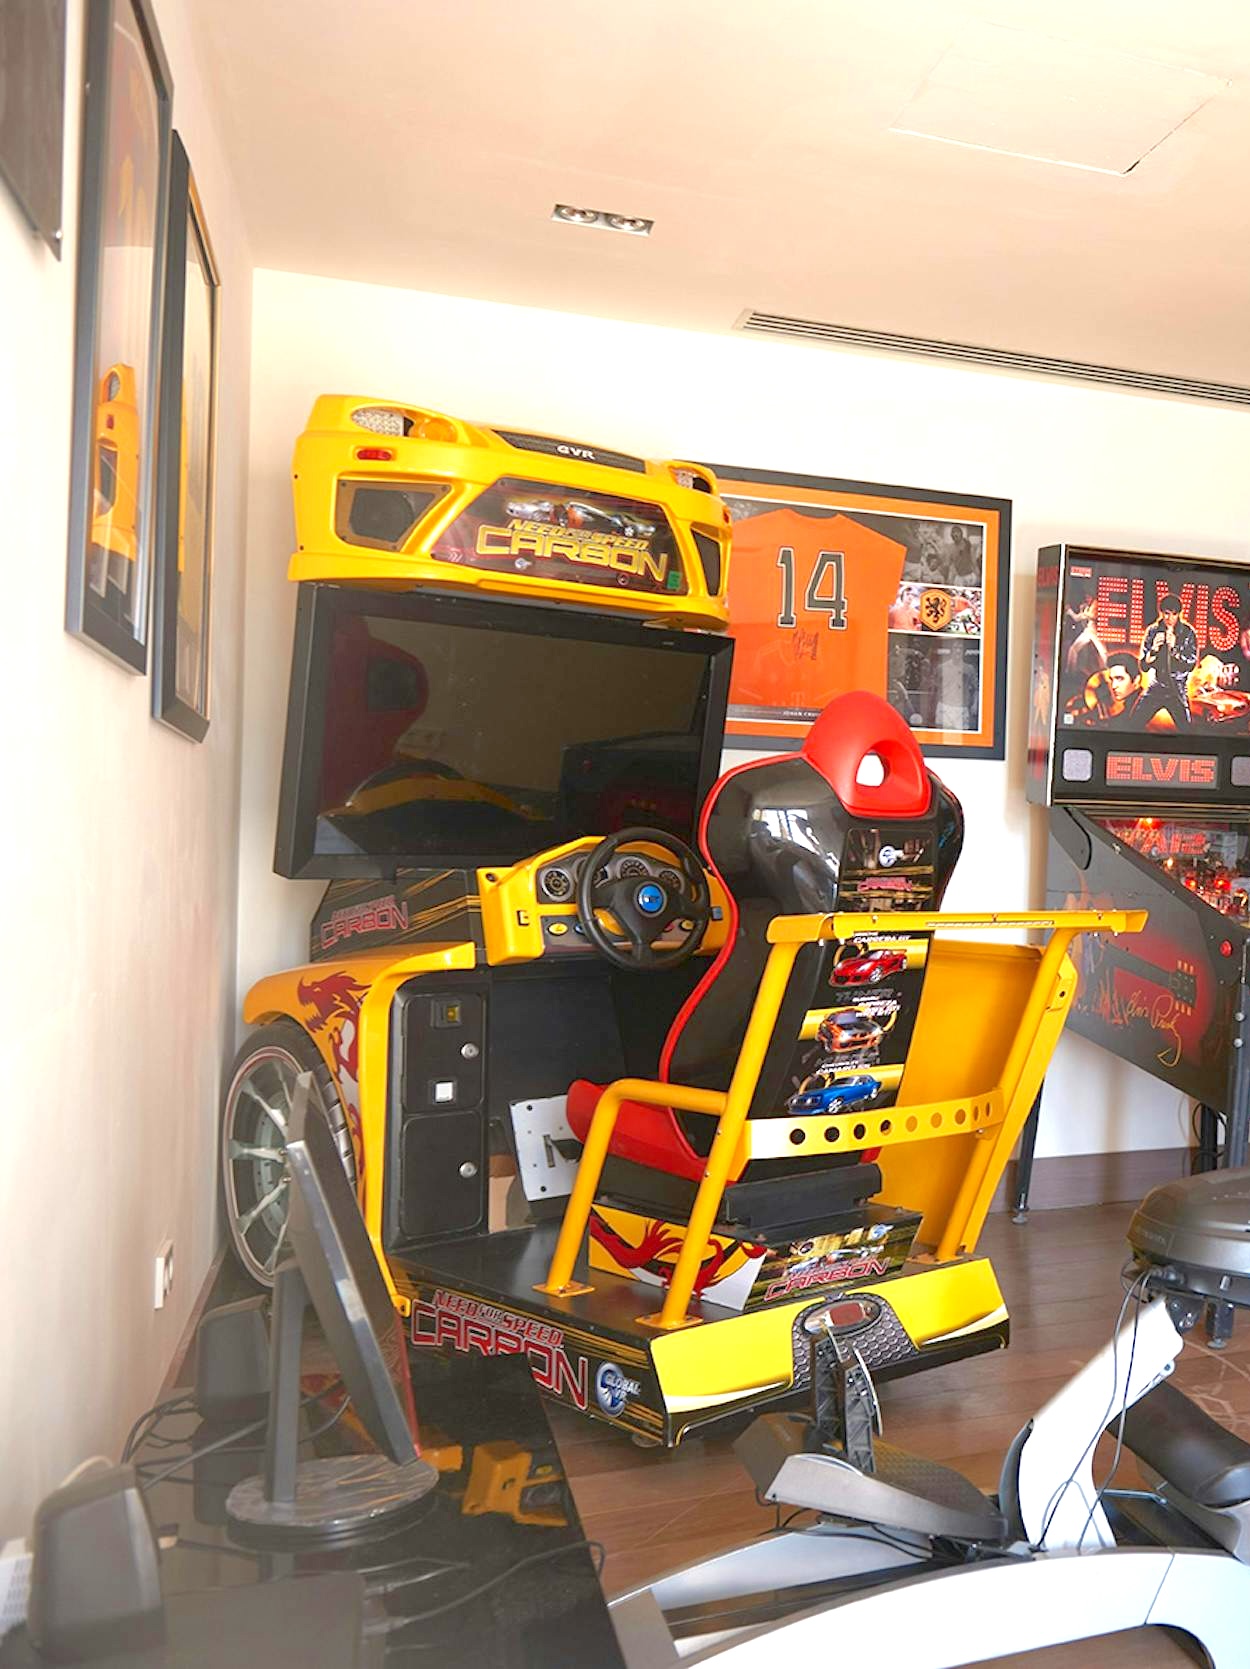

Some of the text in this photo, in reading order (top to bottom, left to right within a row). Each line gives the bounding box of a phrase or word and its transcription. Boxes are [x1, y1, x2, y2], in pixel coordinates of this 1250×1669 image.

[557, 445, 596, 460] GVR
[476, 524, 668, 582] CARBON
[507, 518, 564, 536] NEED
[591, 532, 650, 551] SPEED
[776, 546, 848, 629] 14
[1096, 576, 1240, 652] ELVIS
[1107, 755, 1216, 784] ELVIS
[320, 901, 409, 950] CARBON
[764, 1256, 891, 1302] CARBON
[432, 1288, 565, 1347] NEED FOR SPEED
[604, 1370, 642, 1396] GLOBAL
